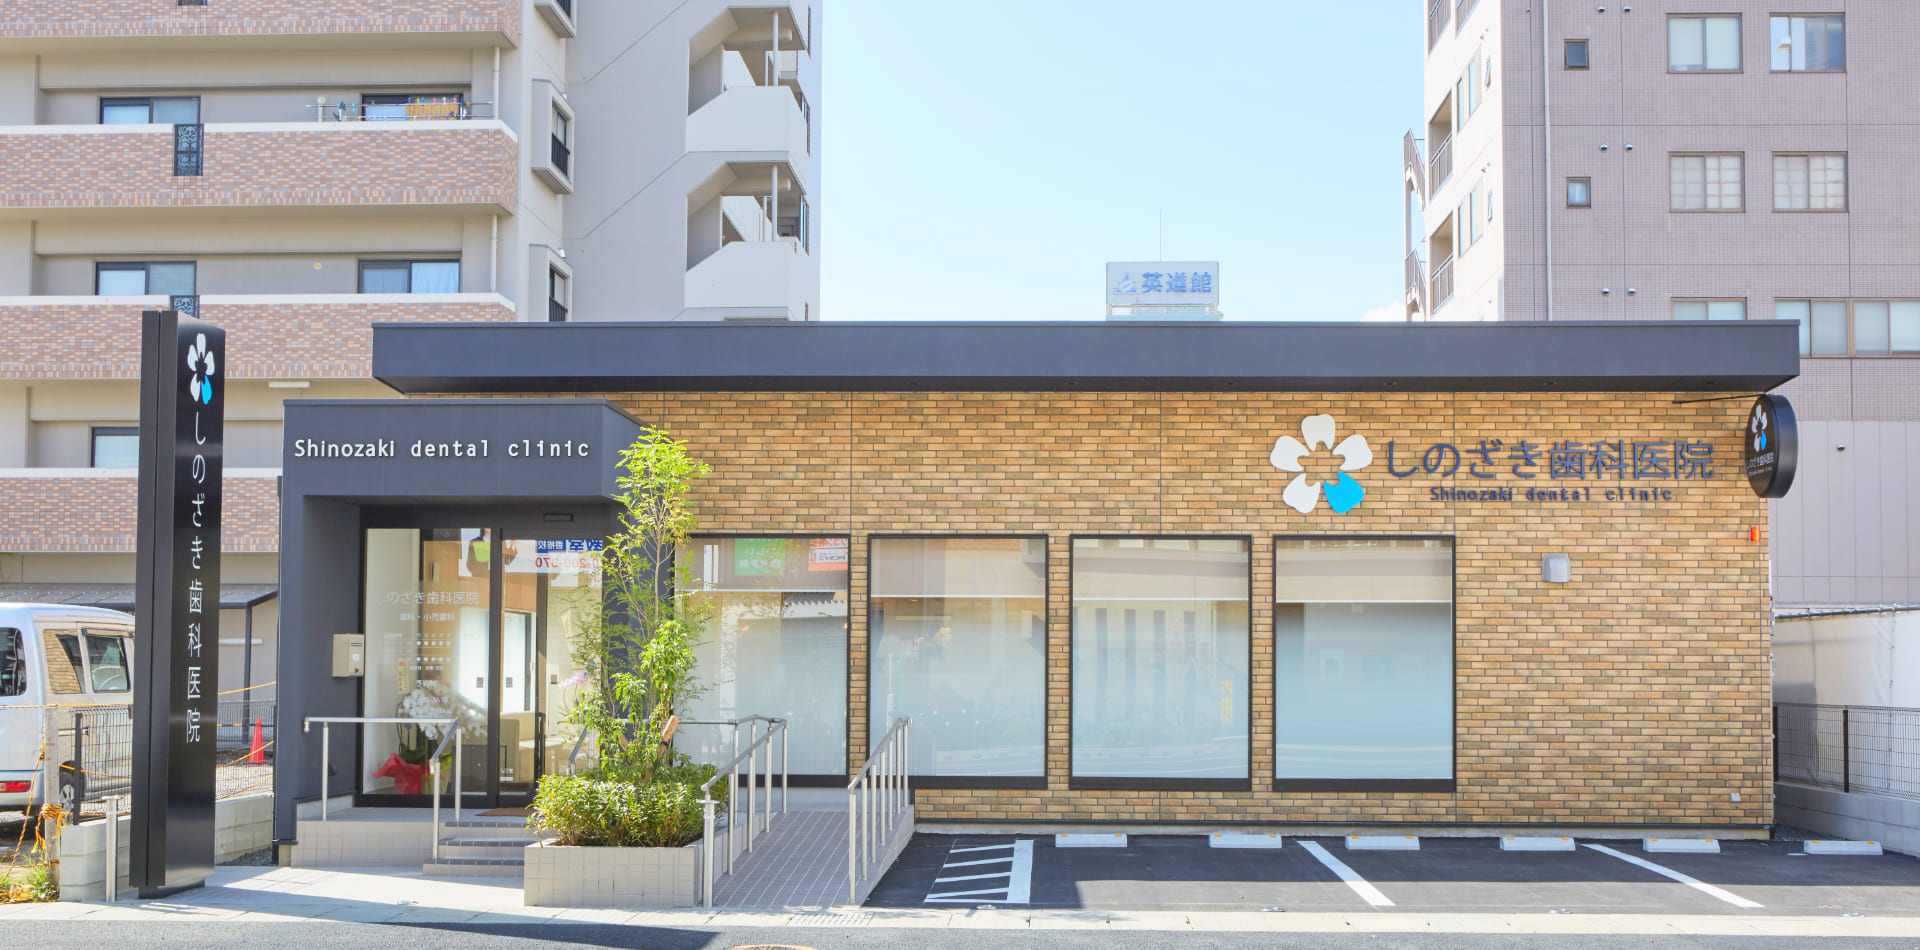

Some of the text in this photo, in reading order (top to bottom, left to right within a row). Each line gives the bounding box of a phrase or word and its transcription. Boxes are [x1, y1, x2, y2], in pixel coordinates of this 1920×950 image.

[1141, 271, 1212, 293] 英進館
[294, 438, 590, 458] Shinozaki dental clinic
[1388, 438, 1714, 480] しのざき歯科医院
[1430, 486, 1673, 501] Shinozaki dental clinic
[186, 411, 207, 744] しのざき歯科医院
[375, 591, 480, 605] しのざき歯科医院
